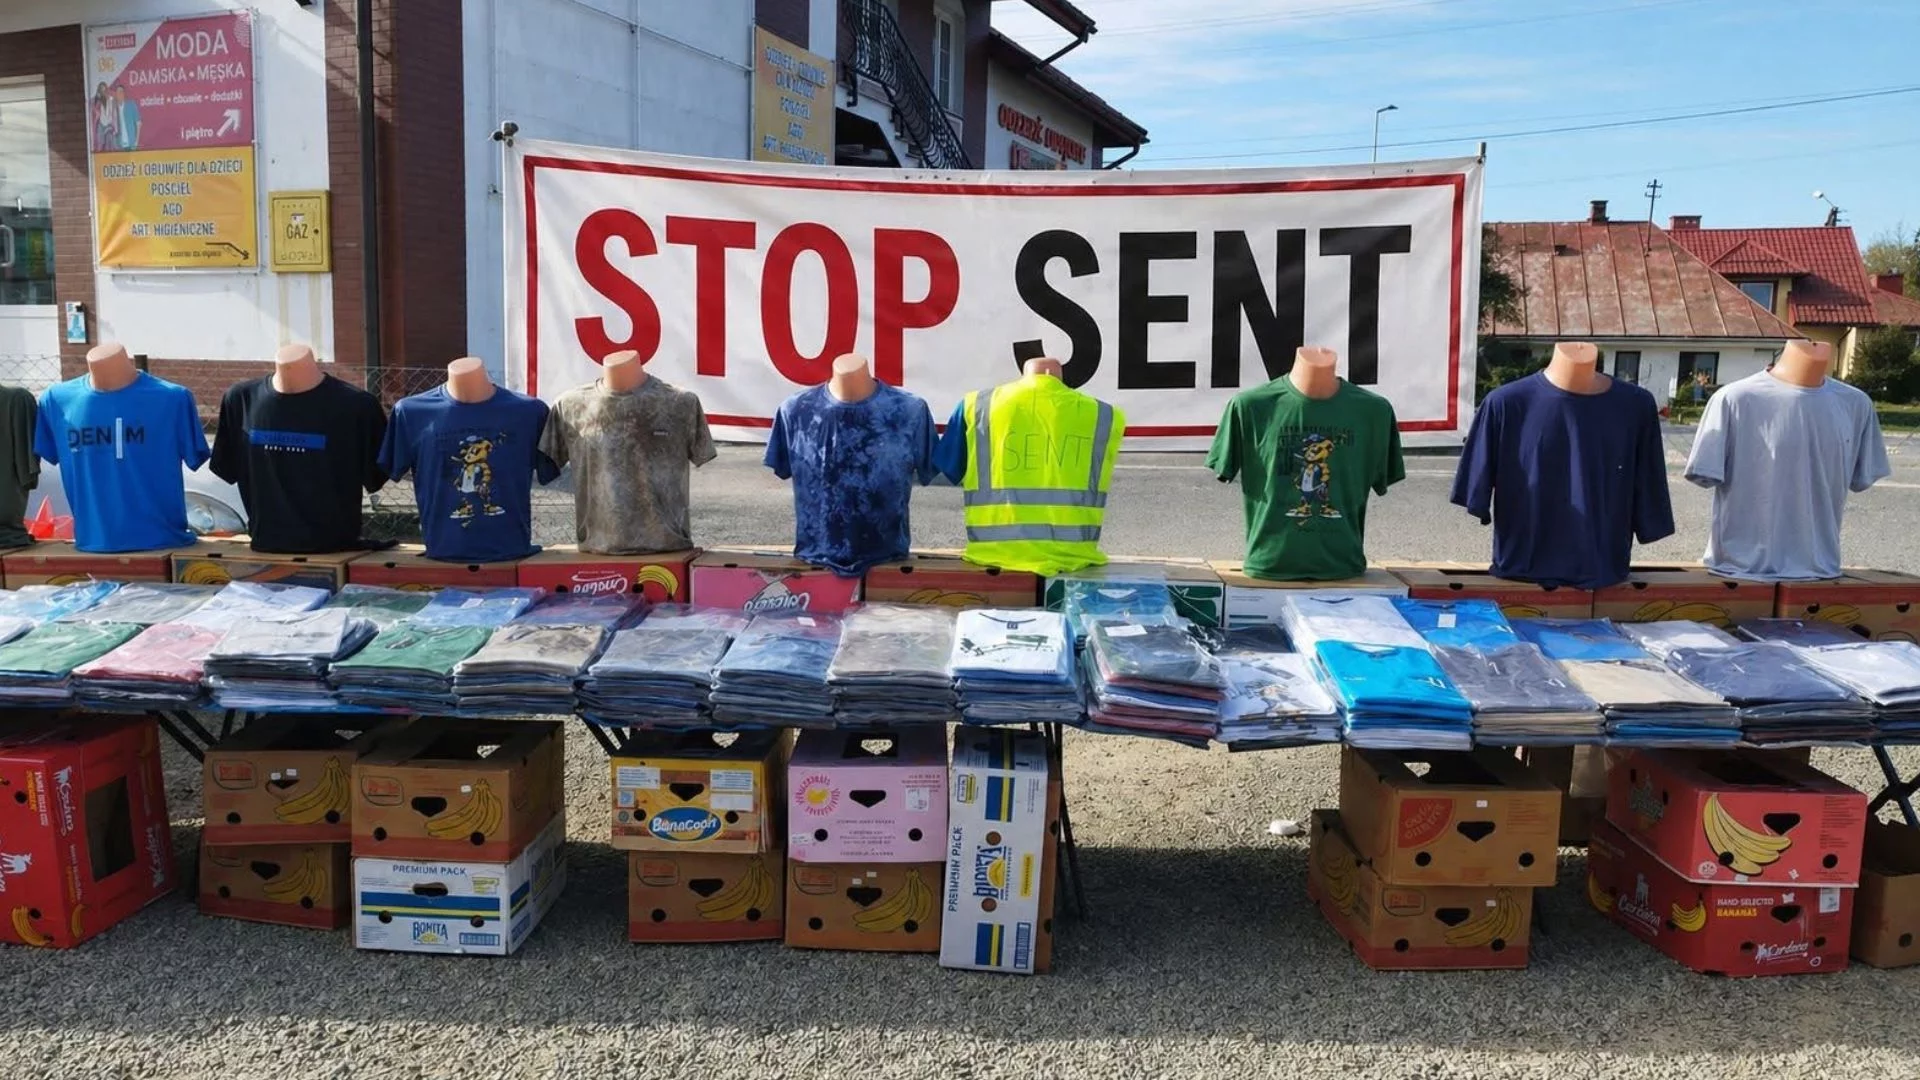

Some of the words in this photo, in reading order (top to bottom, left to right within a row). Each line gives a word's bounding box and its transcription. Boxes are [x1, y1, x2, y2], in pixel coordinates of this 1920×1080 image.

[156, 29, 229, 60] MODA
[129, 67, 188, 87] DAMSKA
[197, 62, 246, 84] MĘSKA
[103, 162, 136, 178] ODZIEŻ
[144, 162, 184, 176] OBUWIE
[187, 161, 207, 175] DLA
[210, 160, 243, 174] DZIECI
[163, 203, 182, 215] AGD
[154, 222, 214, 236] HIGIENICZNE
[286, 223, 308, 239] GAZ
[575, 208, 960, 388] STOP
[1012, 224, 1412, 390] SENT
[68, 417, 145, 459] DENIM
[1003, 431, 1091, 472] SENT
[393, 864, 438, 875] PREMIUM
[441, 866, 467, 876] PACK
[1716, 908, 1757, 917] BANANAS
